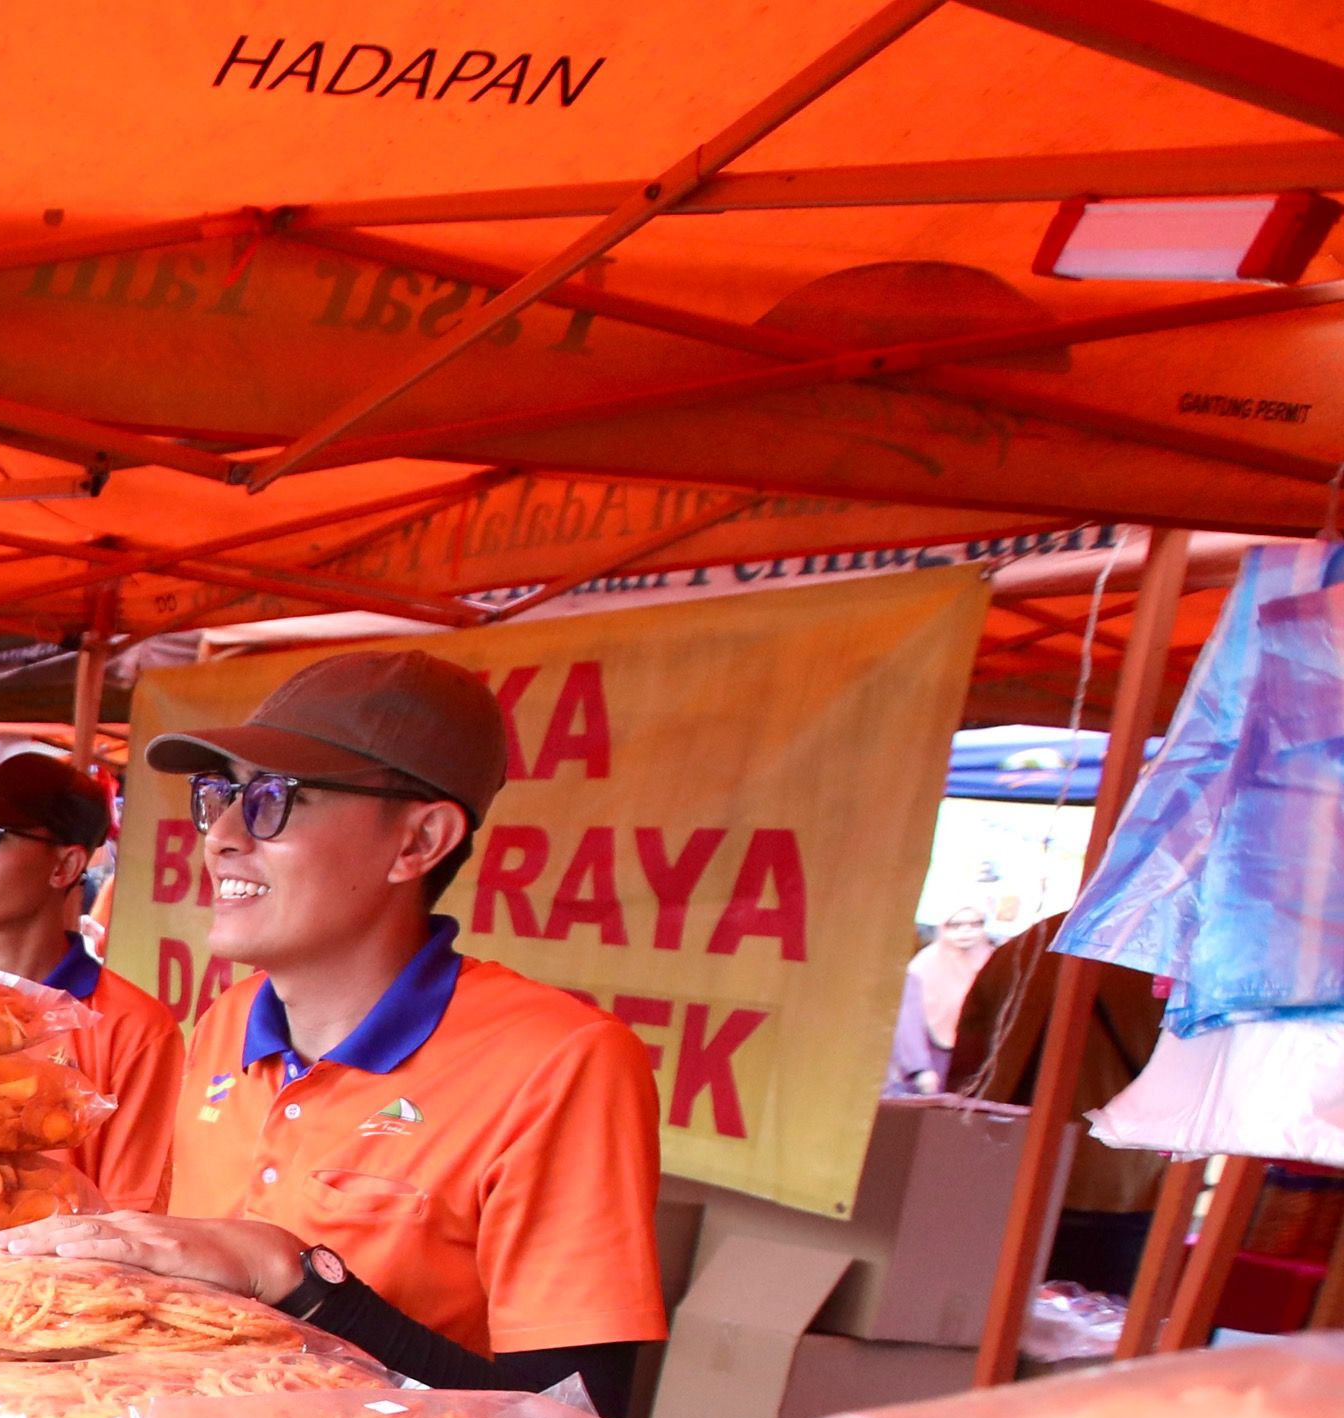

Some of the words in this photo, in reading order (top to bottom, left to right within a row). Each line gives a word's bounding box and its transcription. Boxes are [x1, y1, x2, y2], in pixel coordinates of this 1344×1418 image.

[212, 34, 608, 107] HADAPAN
[1254, 400, 1311, 423] PERMIT
[461, 660, 611, 780] KA
[470, 825, 809, 961] RAYA
